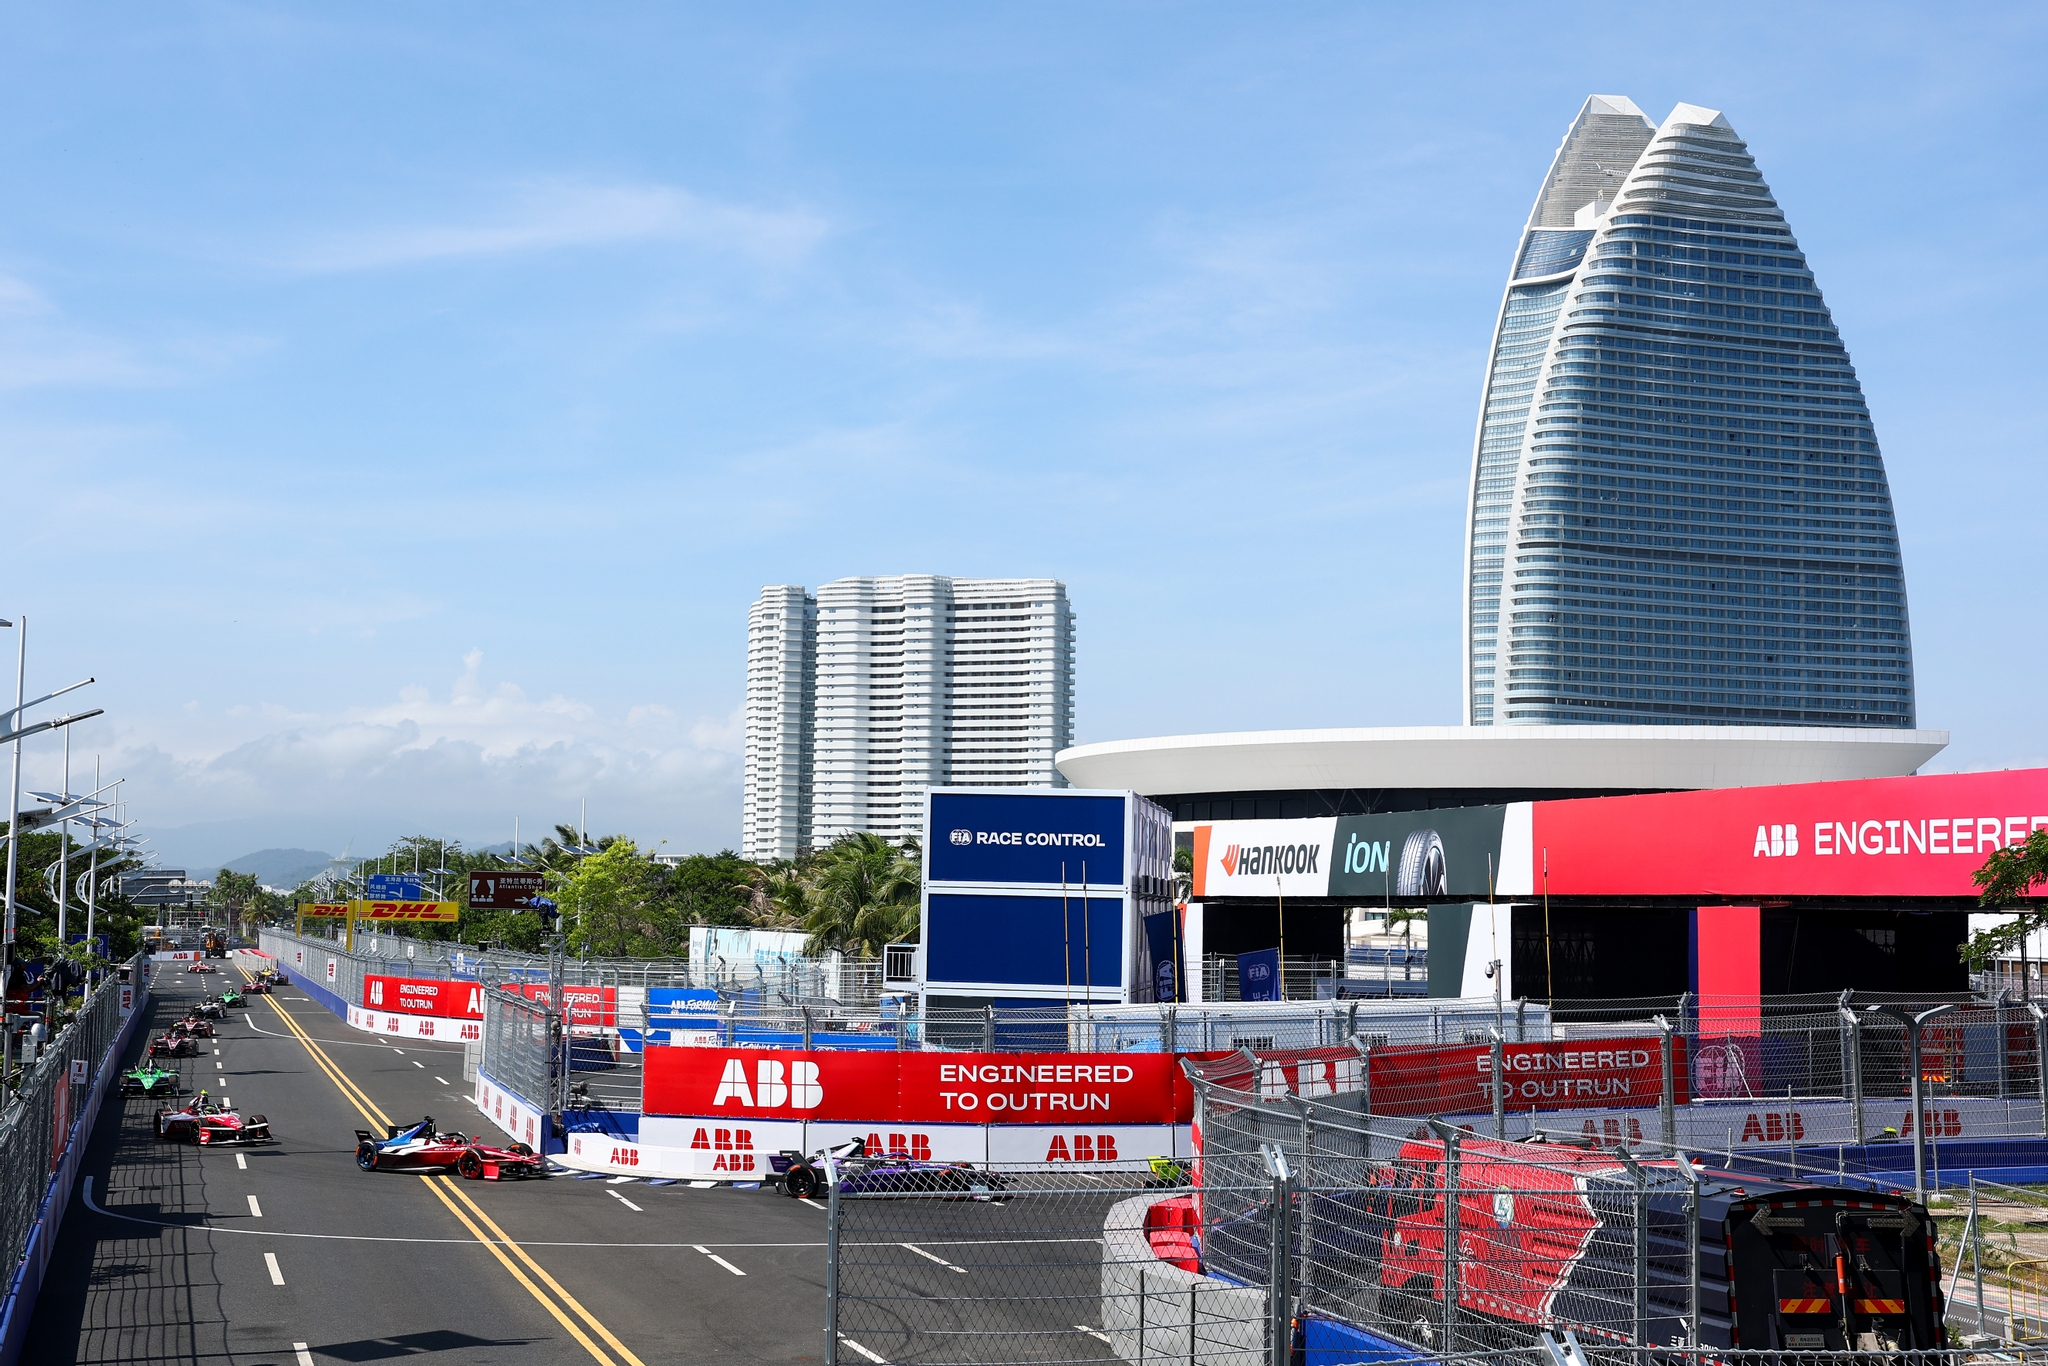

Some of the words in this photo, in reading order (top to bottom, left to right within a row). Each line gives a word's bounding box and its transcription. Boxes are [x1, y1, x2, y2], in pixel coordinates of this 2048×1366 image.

[976, 831, 1023, 846] RACE
[1024, 832, 1106, 847] CONTROL
[1753, 823, 1799, 858] ABB
[1814, 815, 2048, 855] ENGINEERE
[370, 903, 441, 918] DHL
[172, 952, 188, 960] ABB
[122, 989, 131, 1010] ABB
[370, 980, 383, 1005] ABB
[400, 984, 438, 996] ENGINEERED
[407, 998, 433, 1009] OUTRUN
[387, 1017, 399, 1032] ABB
[418, 1020, 434, 1036] ABB
[460, 1024, 480, 1040] ABB
[1476, 1050, 1650, 1072] ENGINEERED
[712, 1058, 824, 1109] ABB
[939, 1064, 1134, 1083] ENGINEERED
[1477, 1079, 1513, 1099] TO
[1520, 1077, 1631, 1098] OUTRUN
[939, 1092, 979, 1111] TO
[986, 1092, 1110, 1111] OUTRUN
[526, 1115, 535, 1146] ABB
[1581, 1118, 1643, 1146] ABB
[1741, 1112, 1804, 1142] ABB
[1901, 1109, 1962, 1138] ABB
[690, 1127, 754, 1150] ABB
[864, 1132, 932, 1161] ABB
[1045, 1134, 1118, 1162] ABB
[610, 1147, 639, 1166] ABB
[712, 1153, 755, 1171] ABB
